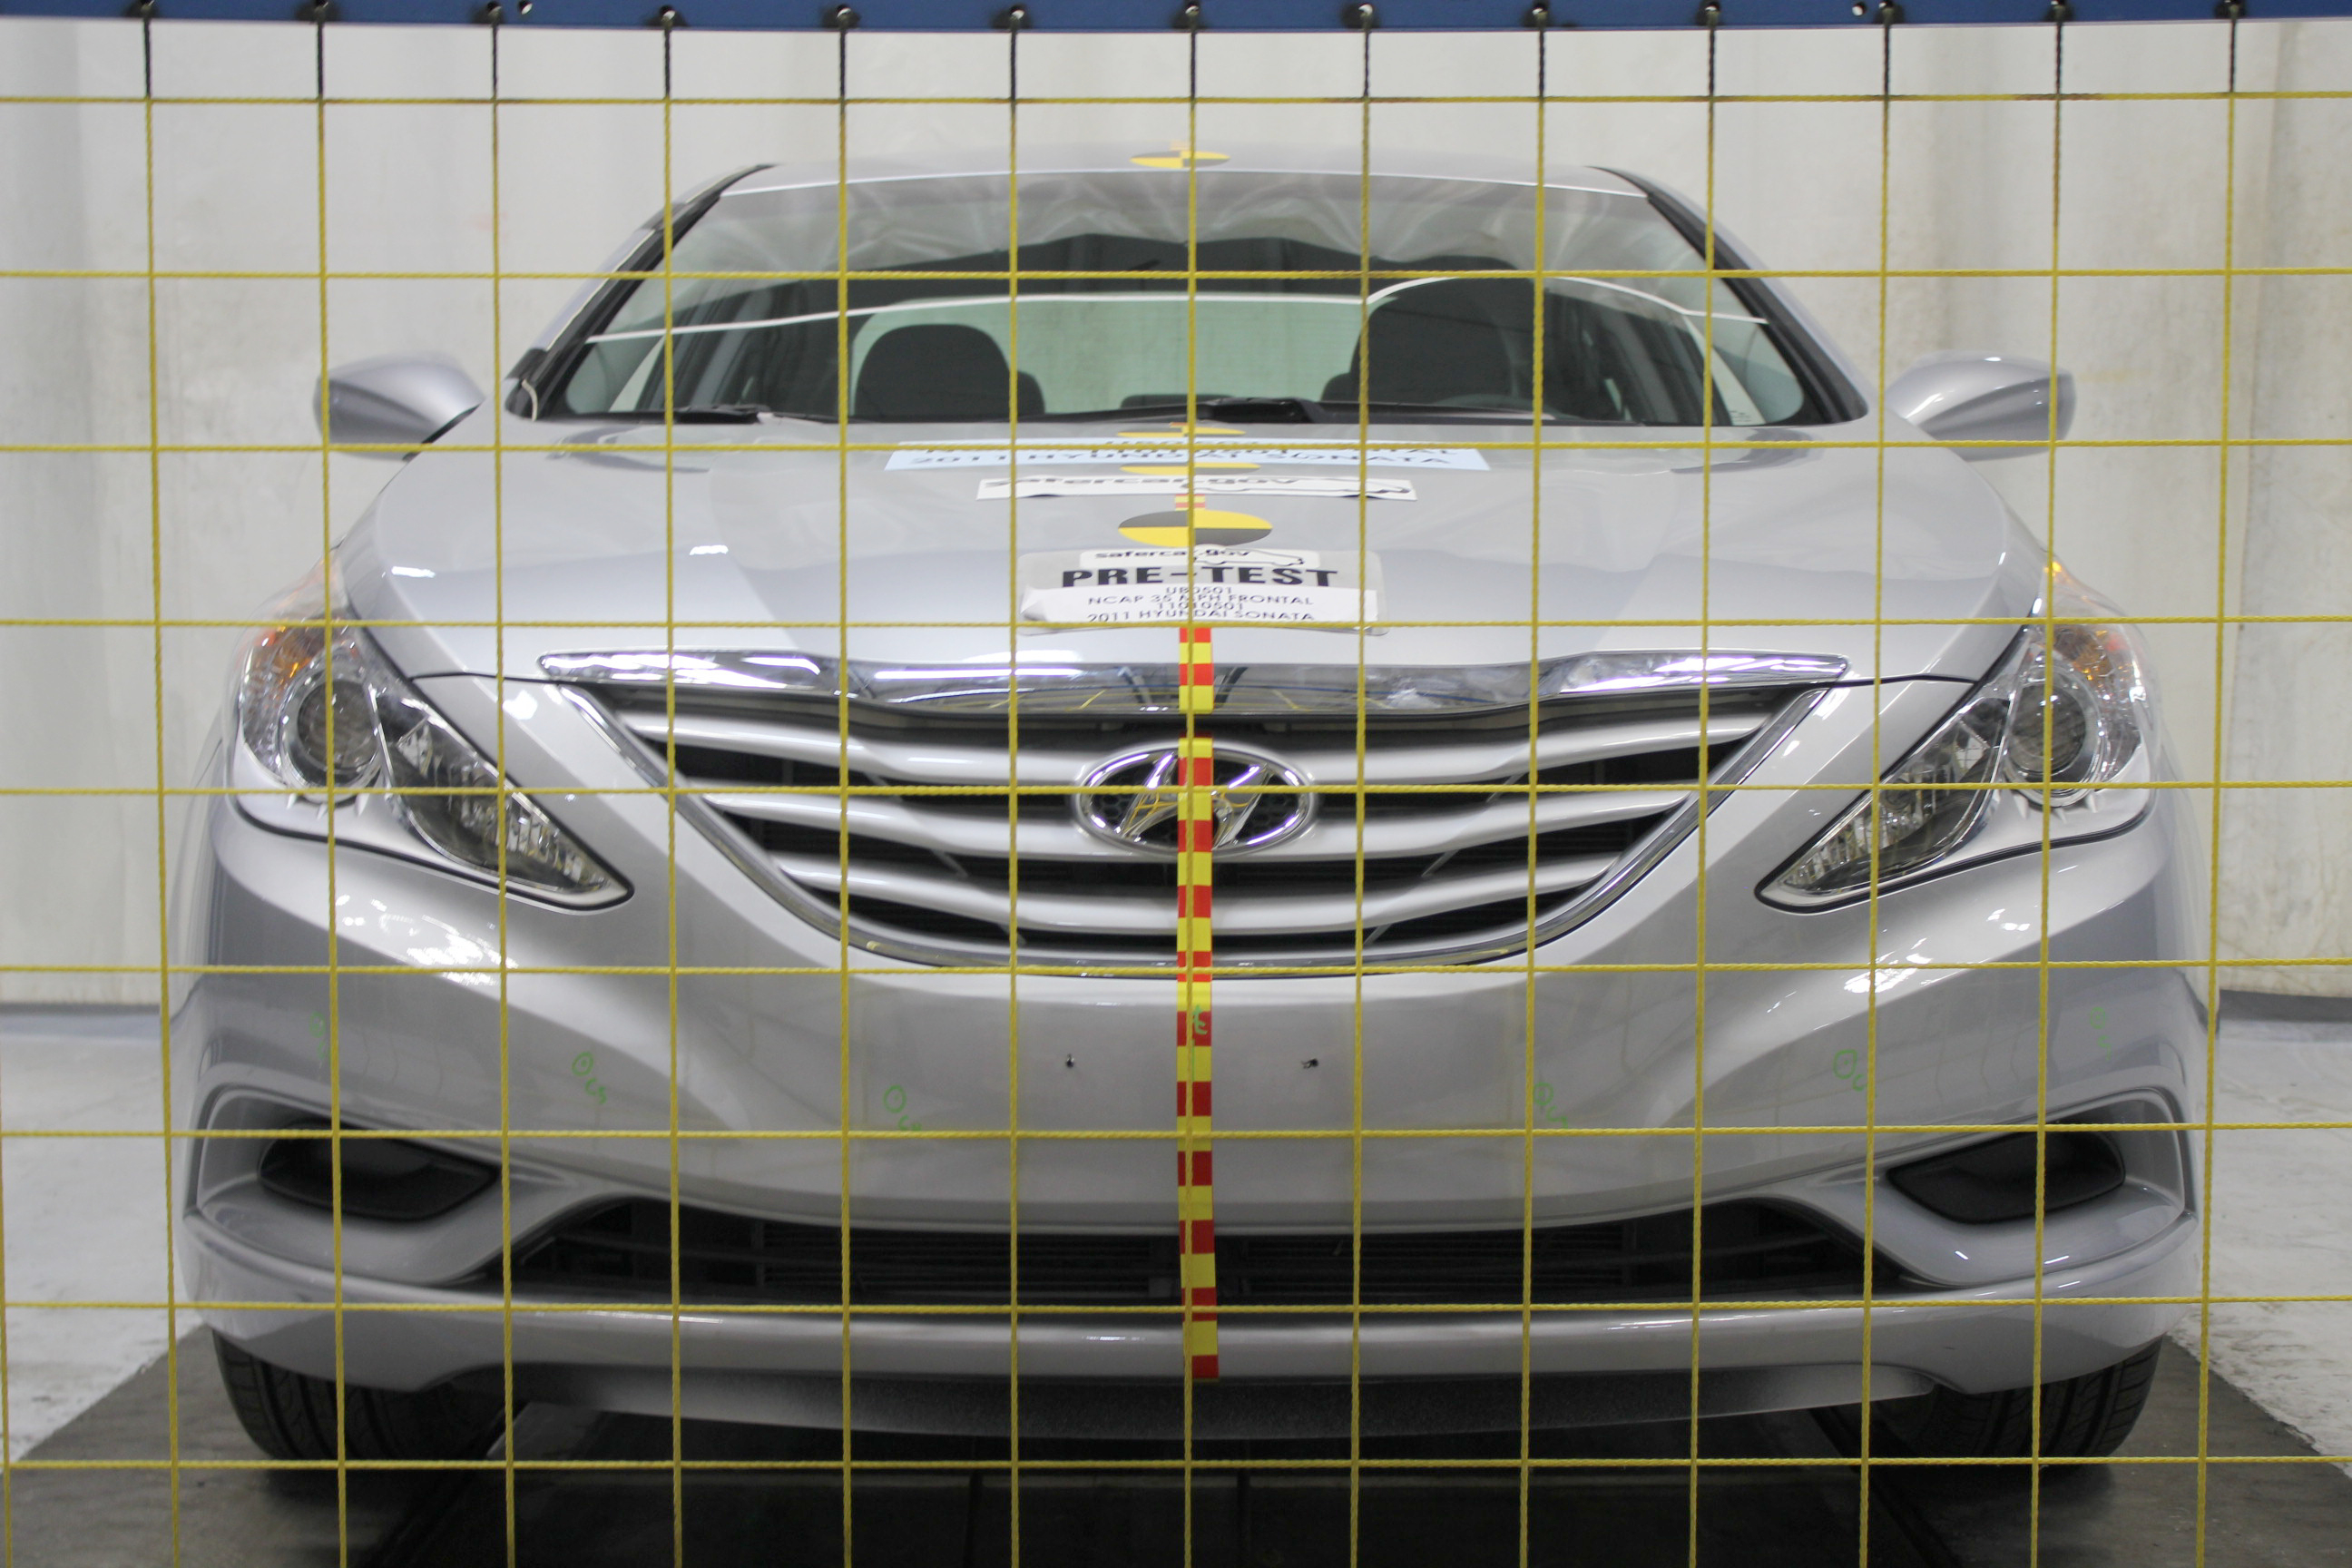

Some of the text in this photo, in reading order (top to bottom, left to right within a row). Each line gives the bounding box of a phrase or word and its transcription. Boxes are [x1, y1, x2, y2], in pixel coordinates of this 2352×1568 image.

[910, 456, 1007, 464] 2011
[1095, 548, 1251, 559] saferca.gov
[1063, 566, 1338, 587] PRE-TEST
[1088, 595, 1143, 605] NCAP
[1179, 593, 1220, 602] MPH
[1229, 594, 1314, 605] FRONTAL
[1087, 609, 1315, 622] 2011 HYUNDAI SONATA
